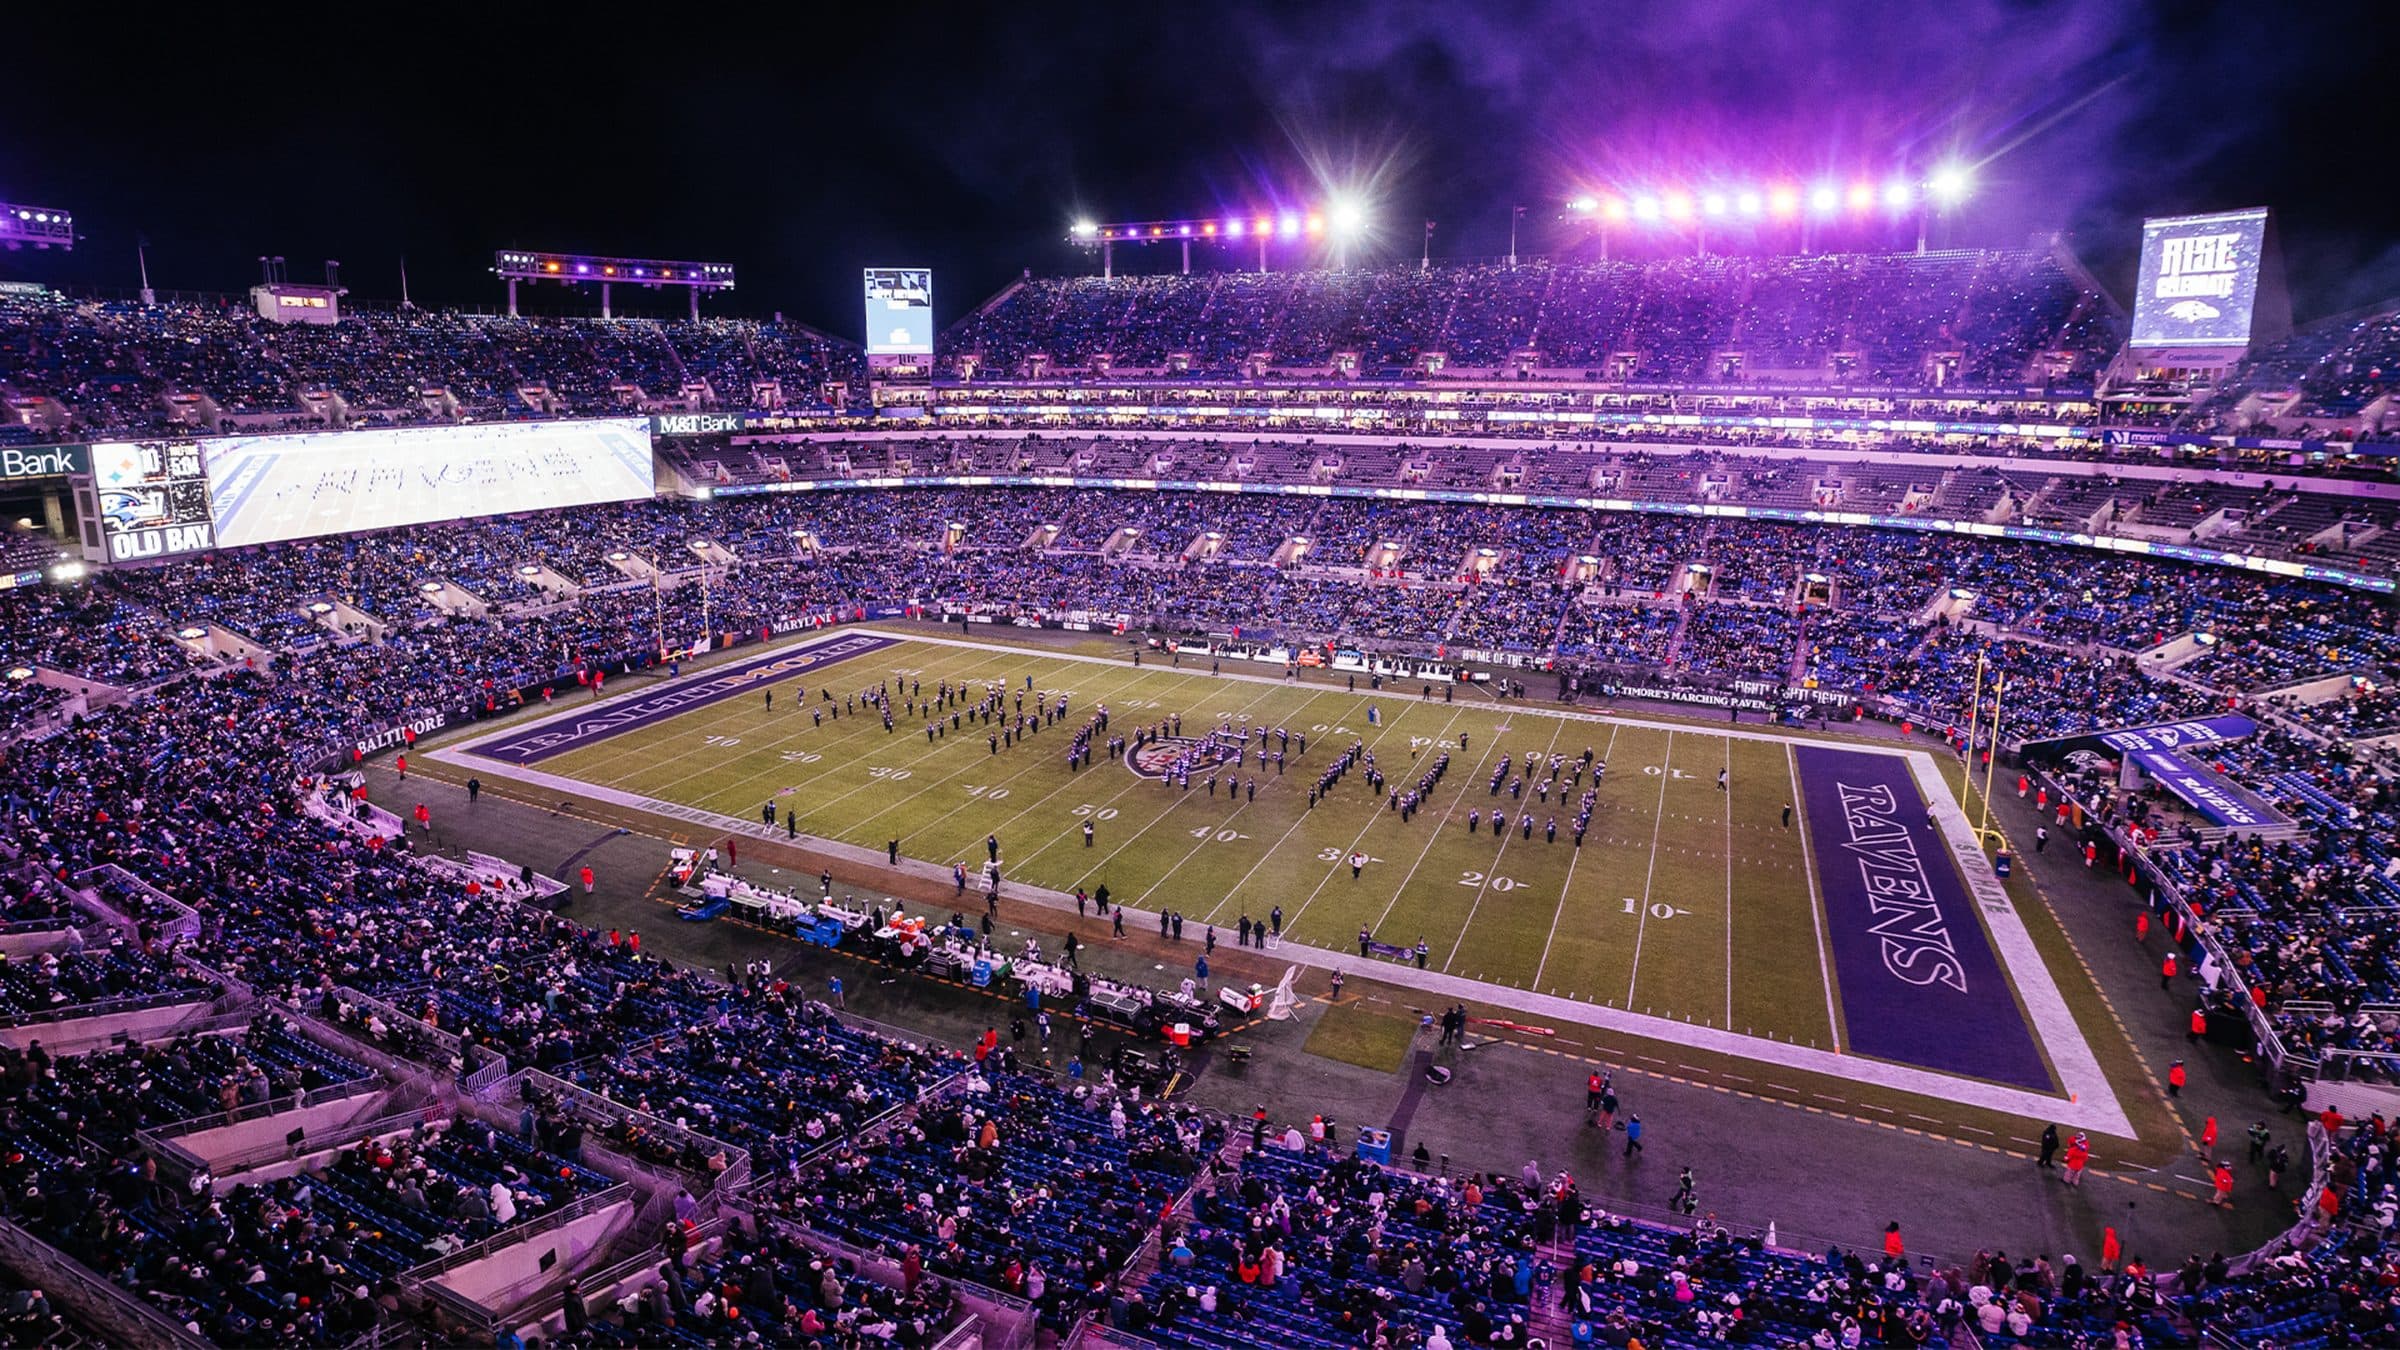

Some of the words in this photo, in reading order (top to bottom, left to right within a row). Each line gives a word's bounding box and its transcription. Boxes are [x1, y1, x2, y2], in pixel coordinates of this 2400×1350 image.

[660, 415, 700, 434] M&T
[701, 413, 738, 432] Bank
[2131, 432, 2168, 443] merritt
[3, 447, 75, 477] Bank
[112, 529, 162, 559] OLD
[1493, 653, 1505, 664] OF
[1507, 654, 1523, 667] THE
[1603, 683, 1670, 700] BTIMORE'S
[1671, 691, 1728, 706] MARCHING
[1731, 697, 1770, 710] RAVEN
[1735, 681, 1770, 696] FIGHT!
[2177, 777, 2256, 824] RAVENS
[636, 799, 721, 825] INSPIRE
[1071, 804, 1119, 821] 50
[1190, 826, 1238, 843] 40
[1458, 871, 1515, 892] 20
[1837, 782, 1967, 994] RAVENS
[1955, 841, 1989, 876] STOP
[1972, 877, 2011, 914] HATE
[1620, 898, 1675, 919] 10
